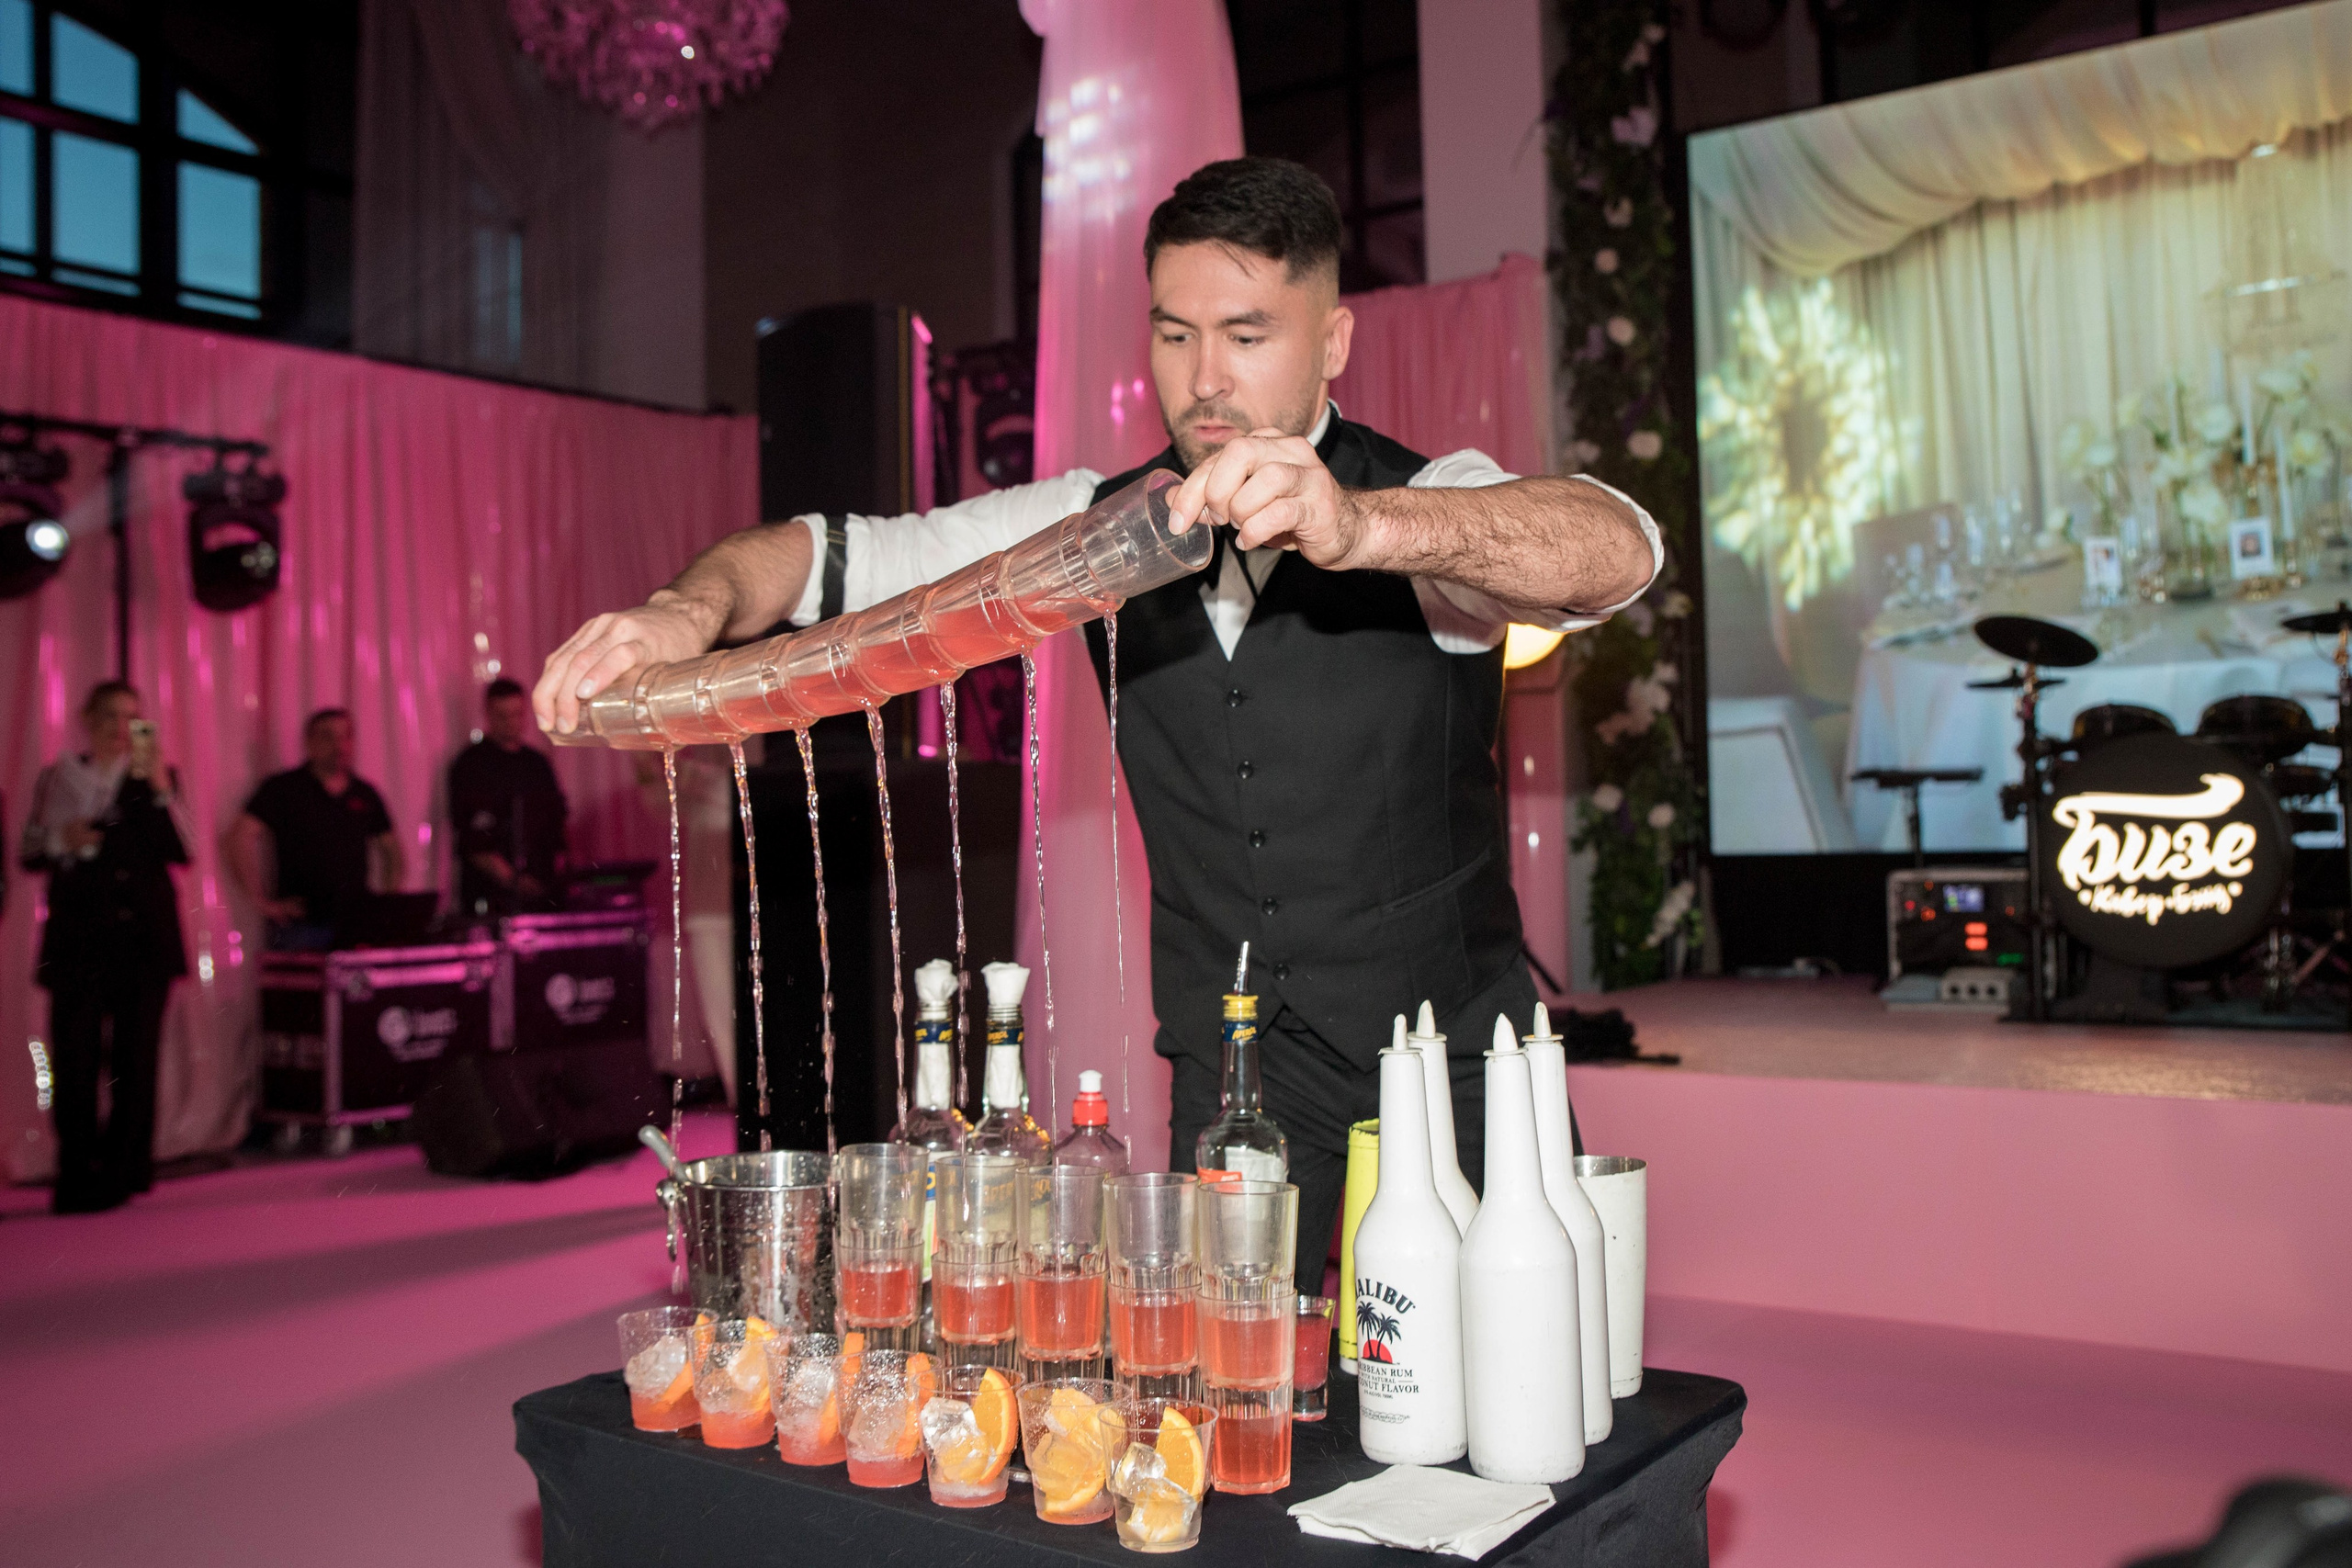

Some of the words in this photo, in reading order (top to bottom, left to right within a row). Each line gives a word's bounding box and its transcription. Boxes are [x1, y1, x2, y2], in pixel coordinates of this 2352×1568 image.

[1355, 1278, 1416, 1314] ALIBU
[1390, 1369, 1413, 1378] RUM
[1381, 1383, 1419, 1393] FLAVOR
